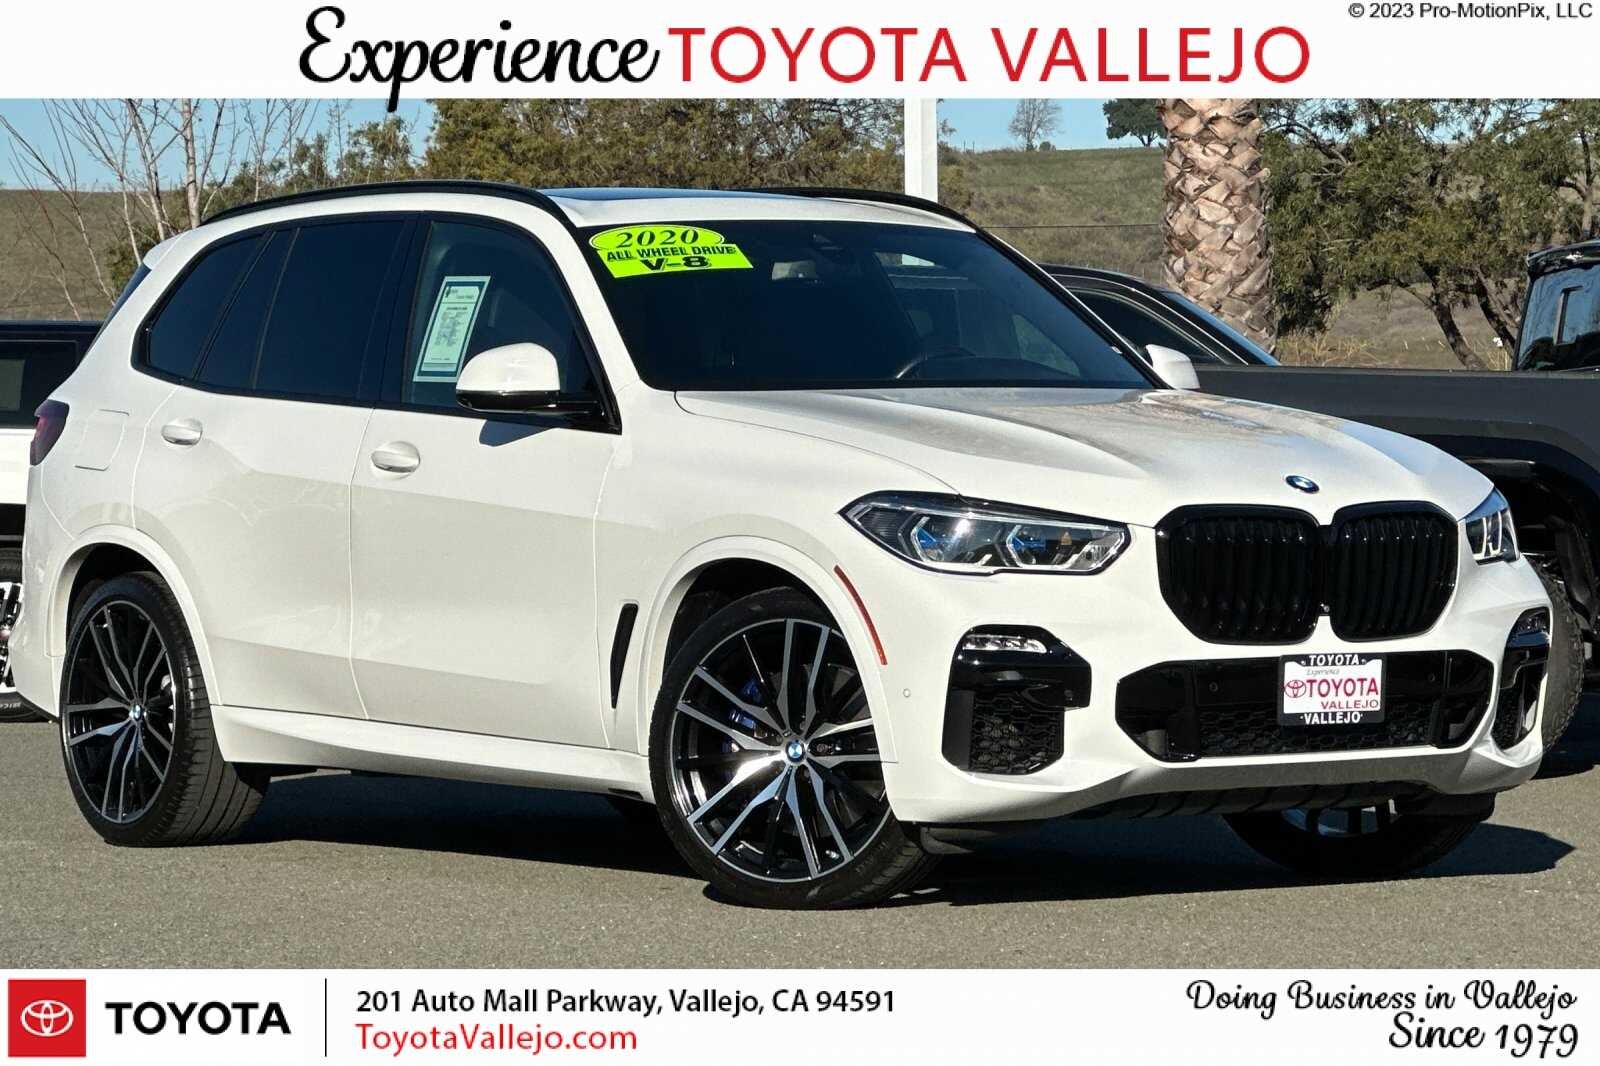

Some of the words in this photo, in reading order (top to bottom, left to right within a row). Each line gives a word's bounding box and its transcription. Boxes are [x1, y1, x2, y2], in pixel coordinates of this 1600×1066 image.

[615, 229, 699, 248] 2020
[606, 250, 634, 262] ALL
[637, 246, 688, 258] WHEEL
[692, 245, 736, 255] DRIVE
[640, 255, 712, 271] V-8
[1308, 654, 1360, 666] TOYOTA
[1306, 678, 1379, 698] TOYOTA
[1320, 699, 1379, 710] VALLEJO
[1303, 711, 1361, 725] VALLEJO
